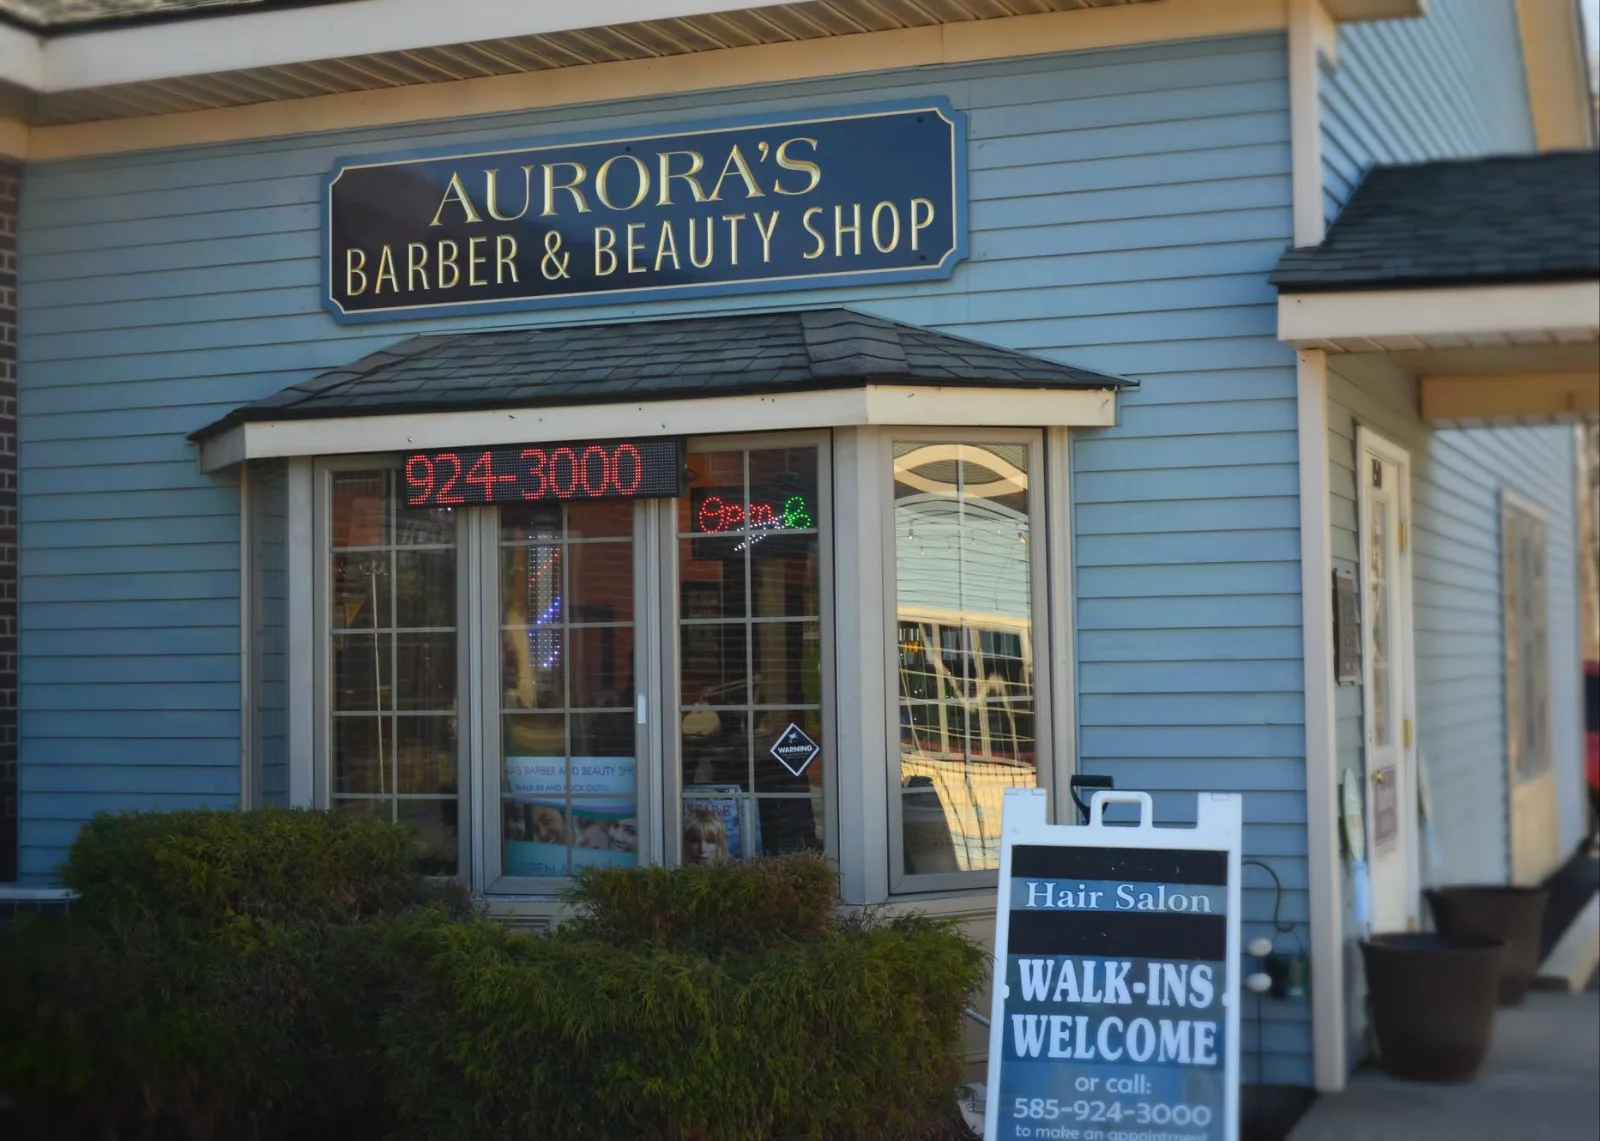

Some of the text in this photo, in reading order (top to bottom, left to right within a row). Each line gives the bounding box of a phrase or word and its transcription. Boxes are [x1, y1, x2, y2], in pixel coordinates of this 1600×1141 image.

[430, 137, 821, 227] AURORA'S
[346, 197, 935, 296] BARBER & BEAUTY SHOP
[405, 443, 642, 505] 924-3000
[778, 745, 813, 754] WARNING
[525, 766, 556, 776] BARBER
[559, 766, 579, 776] AD
[582, 766, 615, 776] BEAUTY
[1025, 881, 1212, 913] Hair Salon
[1018, 958, 1215, 1009] WALK-INS
[1012, 1014, 1217, 1066] WELCOME
[1075, 1073, 1152, 1094] or call:
[1013, 1098, 1212, 1126] 585-924-3000
[1015, 1124, 1031, 1138] to
[1036, 1126, 1080, 1139] make
[1084, 1130, 1104, 1140] an
